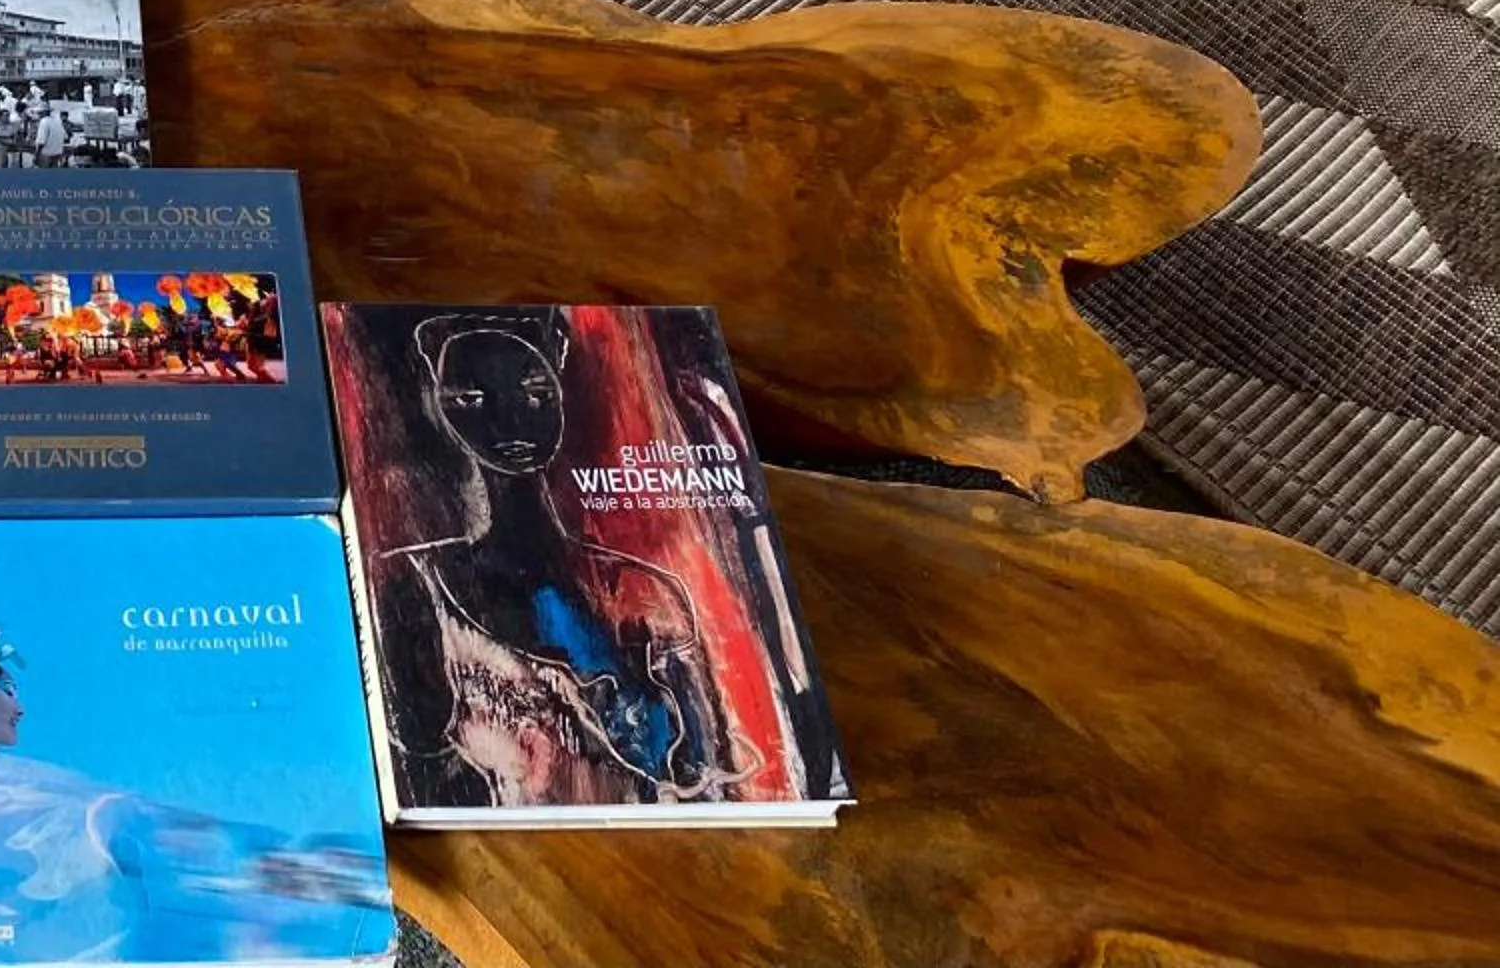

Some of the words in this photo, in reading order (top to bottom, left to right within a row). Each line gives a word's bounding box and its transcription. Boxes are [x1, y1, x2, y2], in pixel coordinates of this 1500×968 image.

[66, 198, 272, 227] FOLCLÓRICAS
[619, 439, 738, 467] guillermo
[572, 466, 746, 494] WIEDEMANN
[580, 494, 619, 512] viaje
[623, 496, 634, 510] a
[636, 494, 652, 510] la
[656, 491, 751, 510] abstracción
[121, 593, 304, 629] carnaval
[123, 633, 148, 652] de
